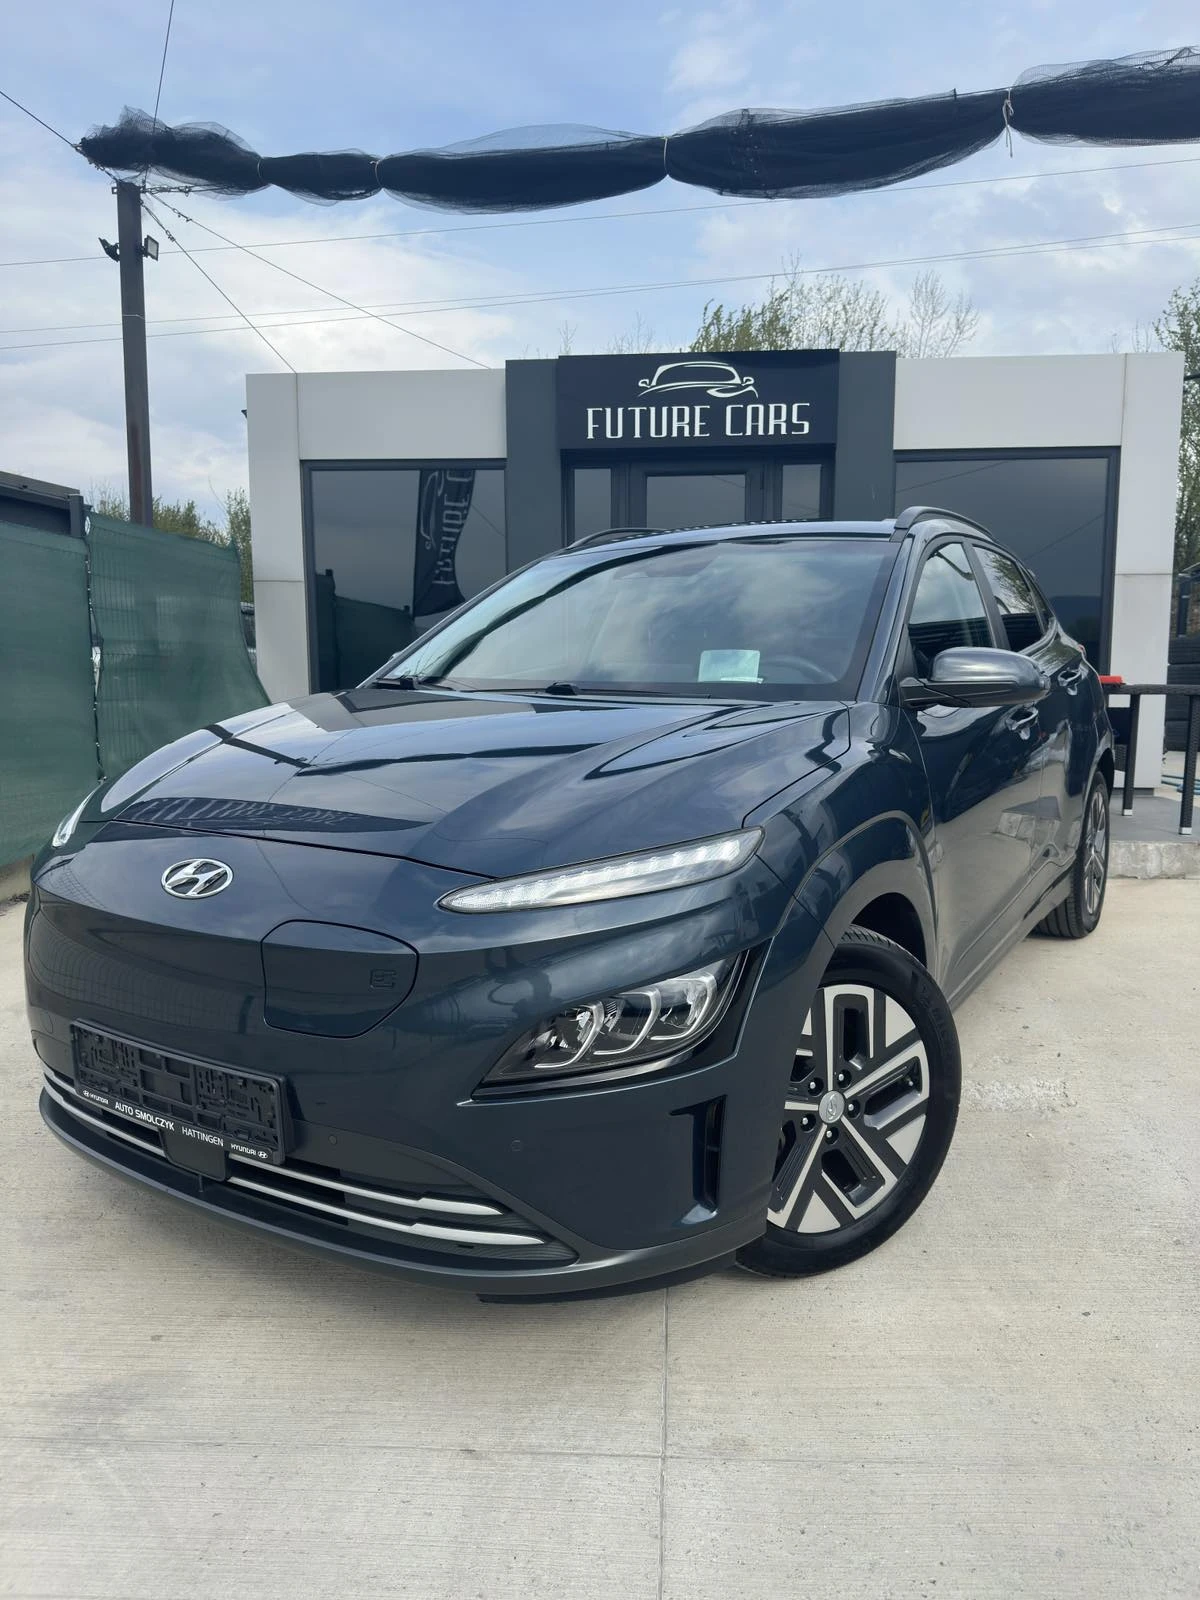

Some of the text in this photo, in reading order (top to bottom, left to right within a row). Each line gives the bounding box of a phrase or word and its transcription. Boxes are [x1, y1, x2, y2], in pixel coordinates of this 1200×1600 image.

[586, 402, 810, 440] FUTURE CARS
[89, 1093, 257, 1156] HYUNDAI AUTO SMOLCZYK HATTINGEN HYUNDAI
